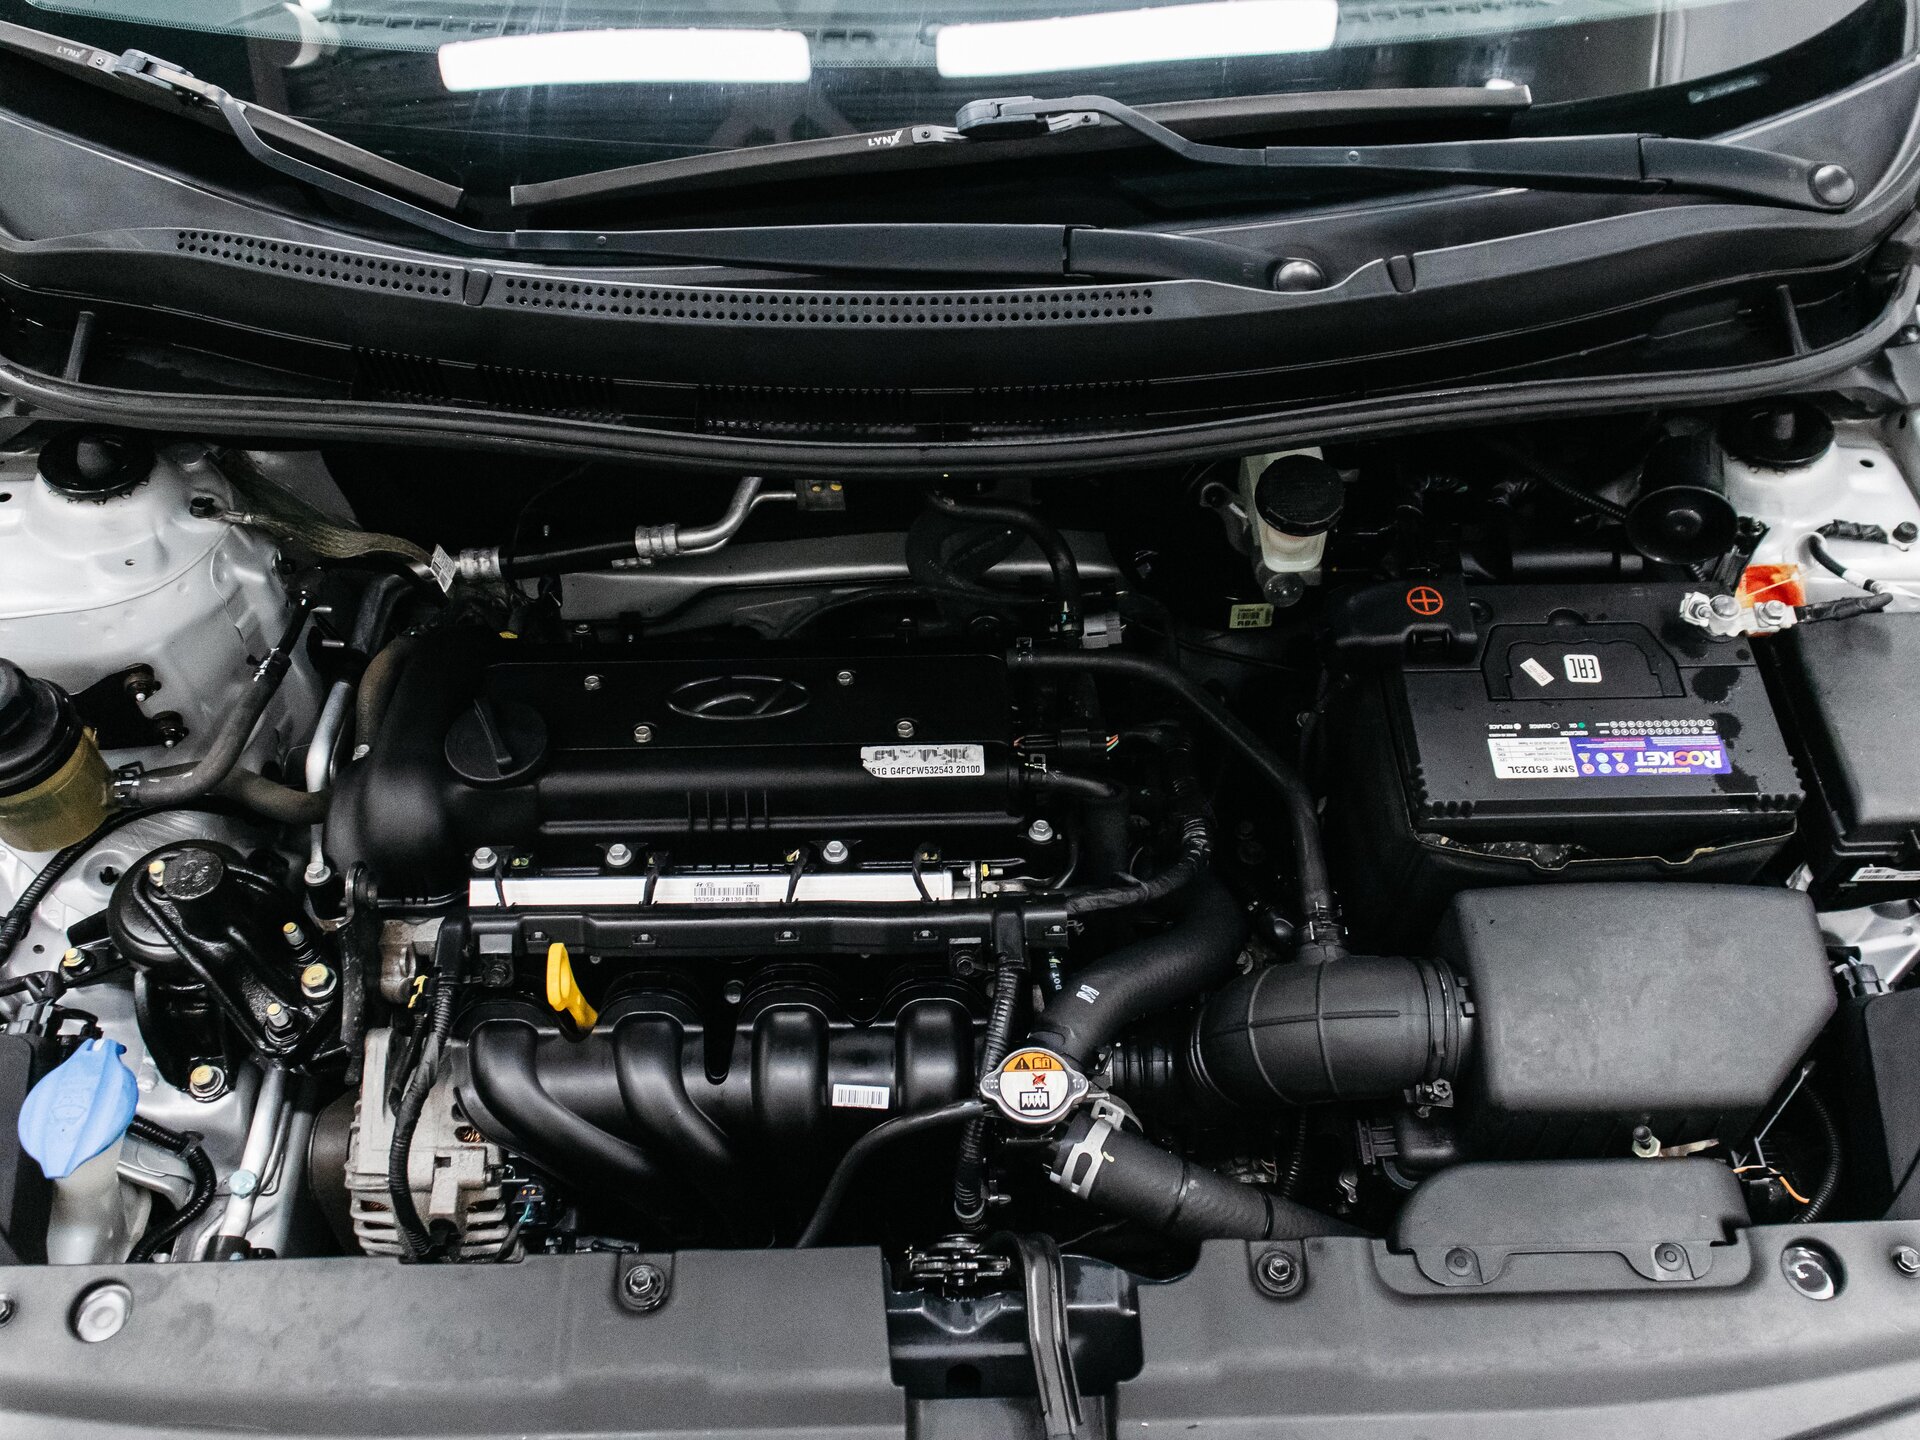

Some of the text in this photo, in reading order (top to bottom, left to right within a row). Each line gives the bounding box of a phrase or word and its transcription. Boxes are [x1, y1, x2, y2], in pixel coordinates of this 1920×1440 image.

[867, 129, 904, 147] LYNX
[1568, 658, 1598, 679] EAC
[1634, 750, 1723, 769] ROCKET
[868, 764, 981, 776] 61G G4FCFW532543 20100
[1507, 765, 1576, 774] SMF 85D23L
[1051, 972, 1063, 990] DOT
